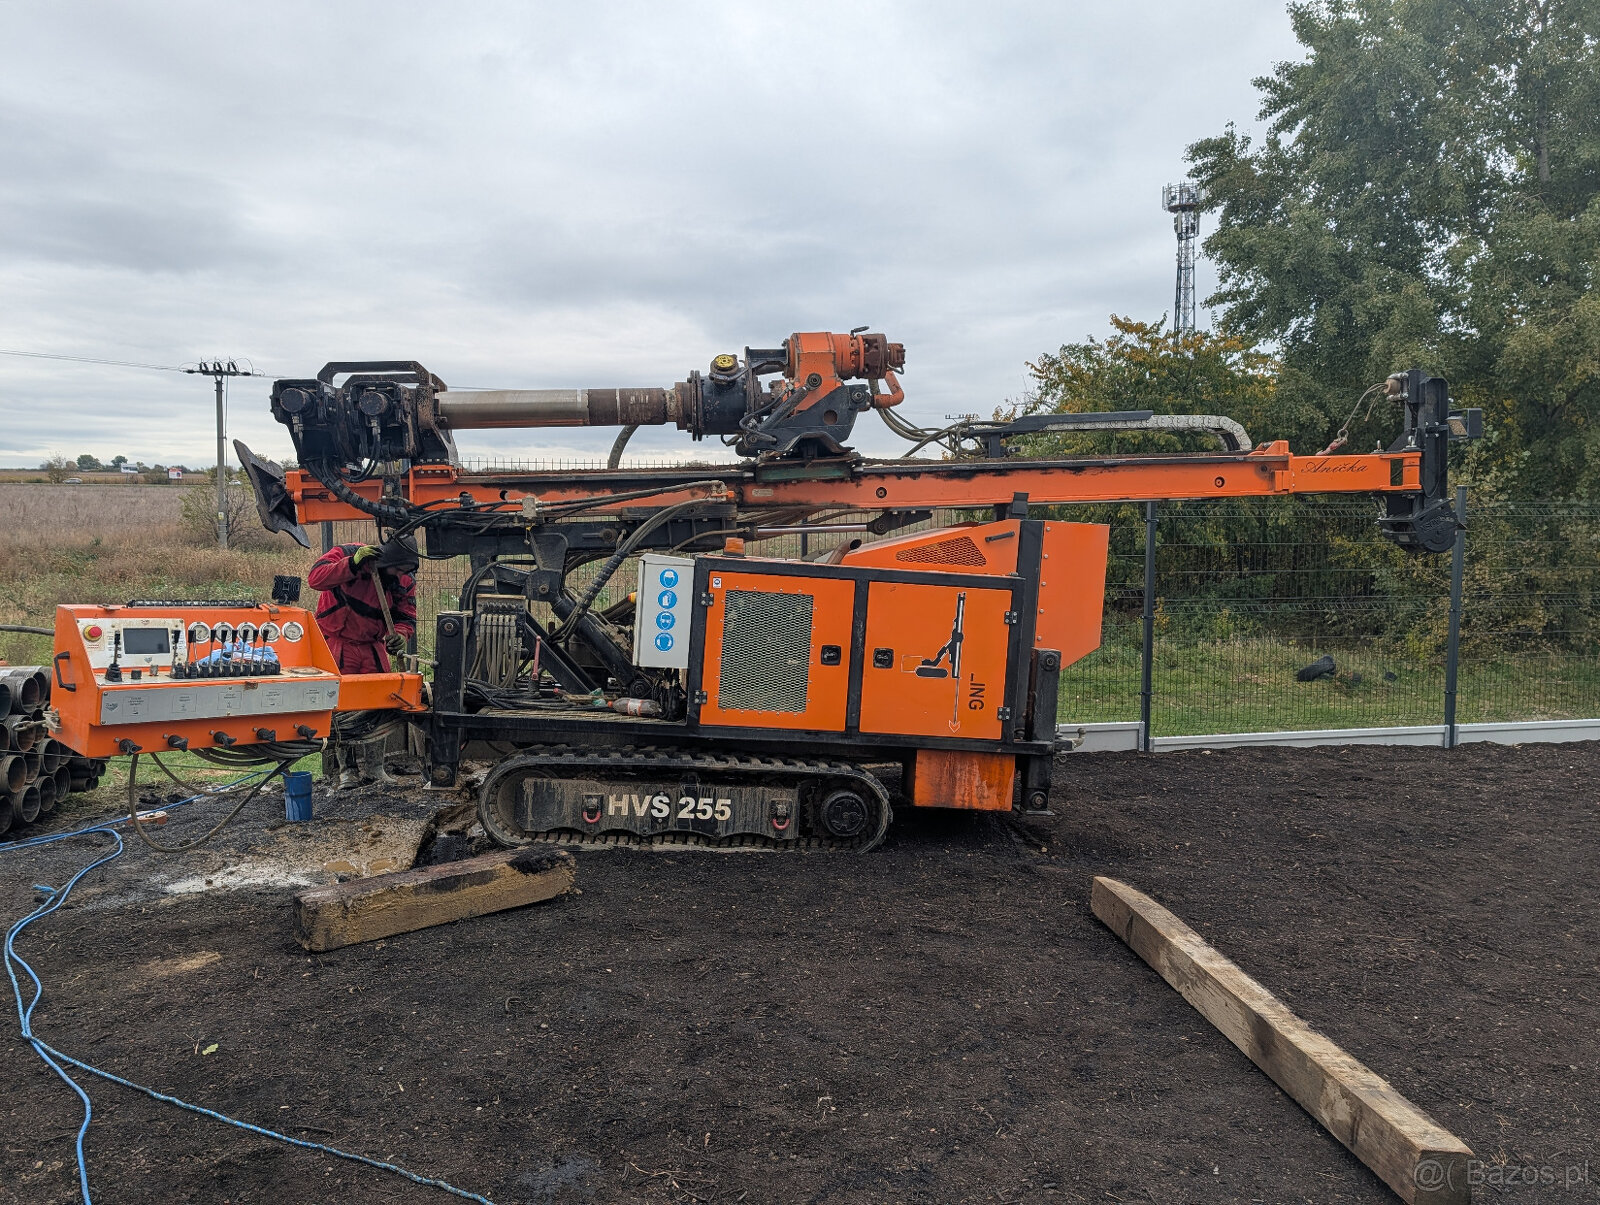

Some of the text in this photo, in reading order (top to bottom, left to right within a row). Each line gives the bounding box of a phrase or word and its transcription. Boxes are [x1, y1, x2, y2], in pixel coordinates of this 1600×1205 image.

[1301, 457, 1369, 473] Anička
[608, 794, 732, 821] HVS 255
